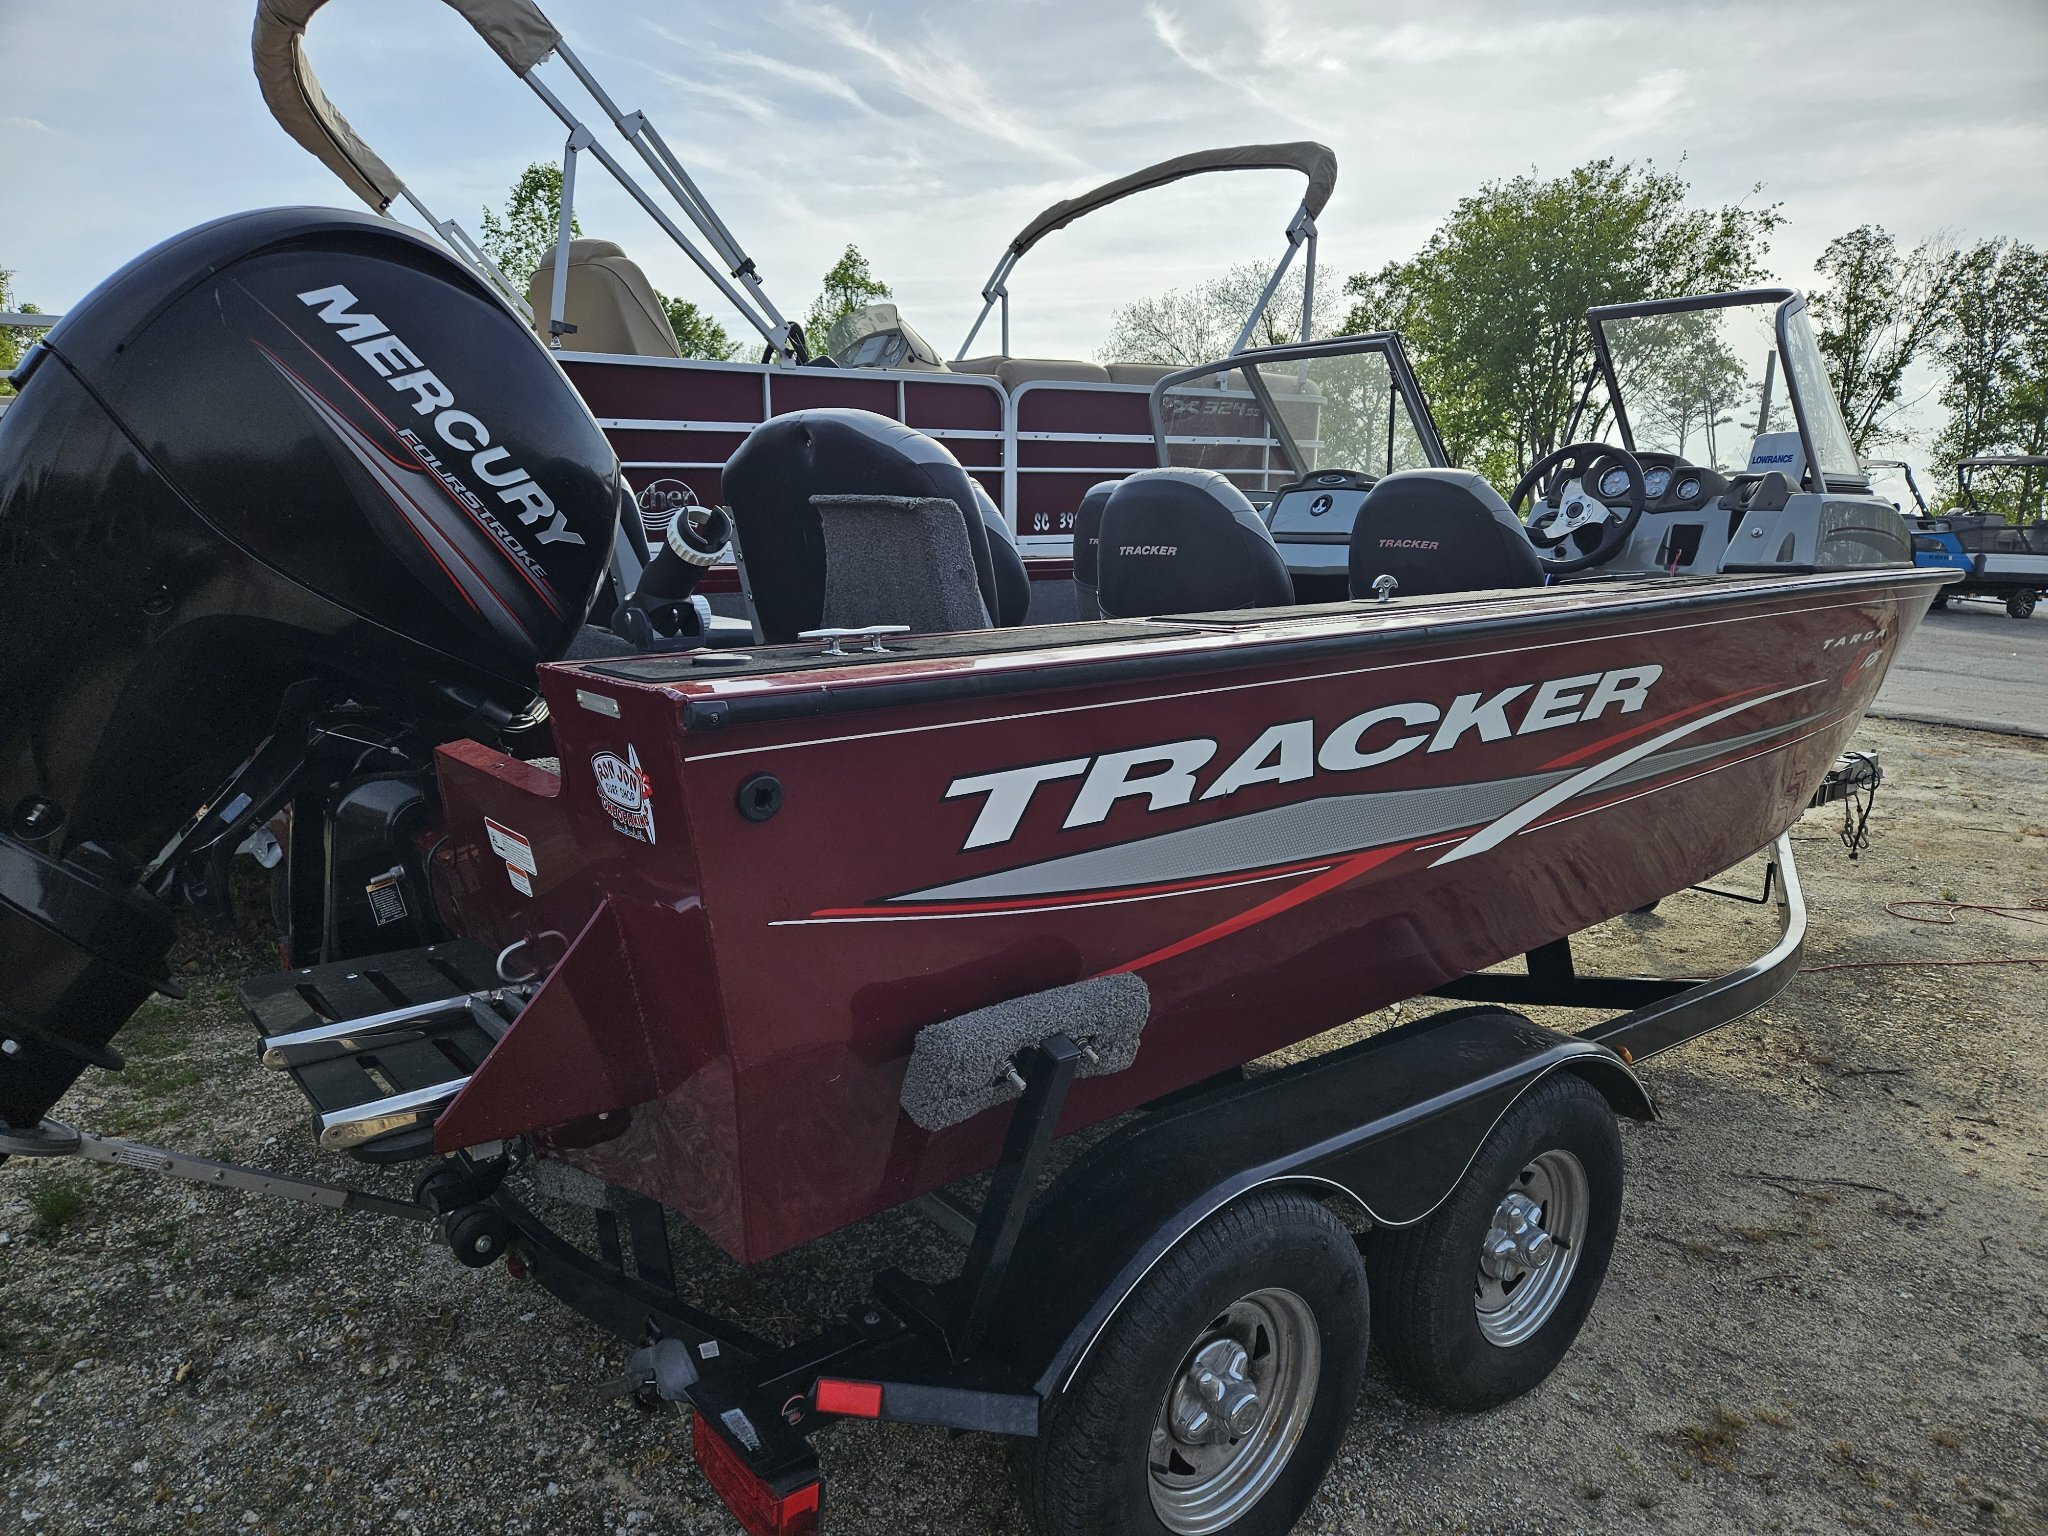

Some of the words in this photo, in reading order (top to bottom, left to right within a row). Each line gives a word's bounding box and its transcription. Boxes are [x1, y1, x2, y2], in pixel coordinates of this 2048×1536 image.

[297, 284, 585, 544] MERCURY
[1752, 454, 1794, 465] LOWRANCE
[396, 428, 548, 579] FOURSTROKE
[635, 483, 693, 509] cher
[1033, 512, 1050, 531] SC
[1059, 511, 1077, 529] 39
[1119, 545, 1178, 556] TRACKER
[1379, 539, 1440, 550] TRACKER
[1823, 629, 1887, 651] TARGA
[945, 664, 1664, 851] TRACKER
[597, 760, 615, 781] RON
[616, 764, 638, 793] JON
